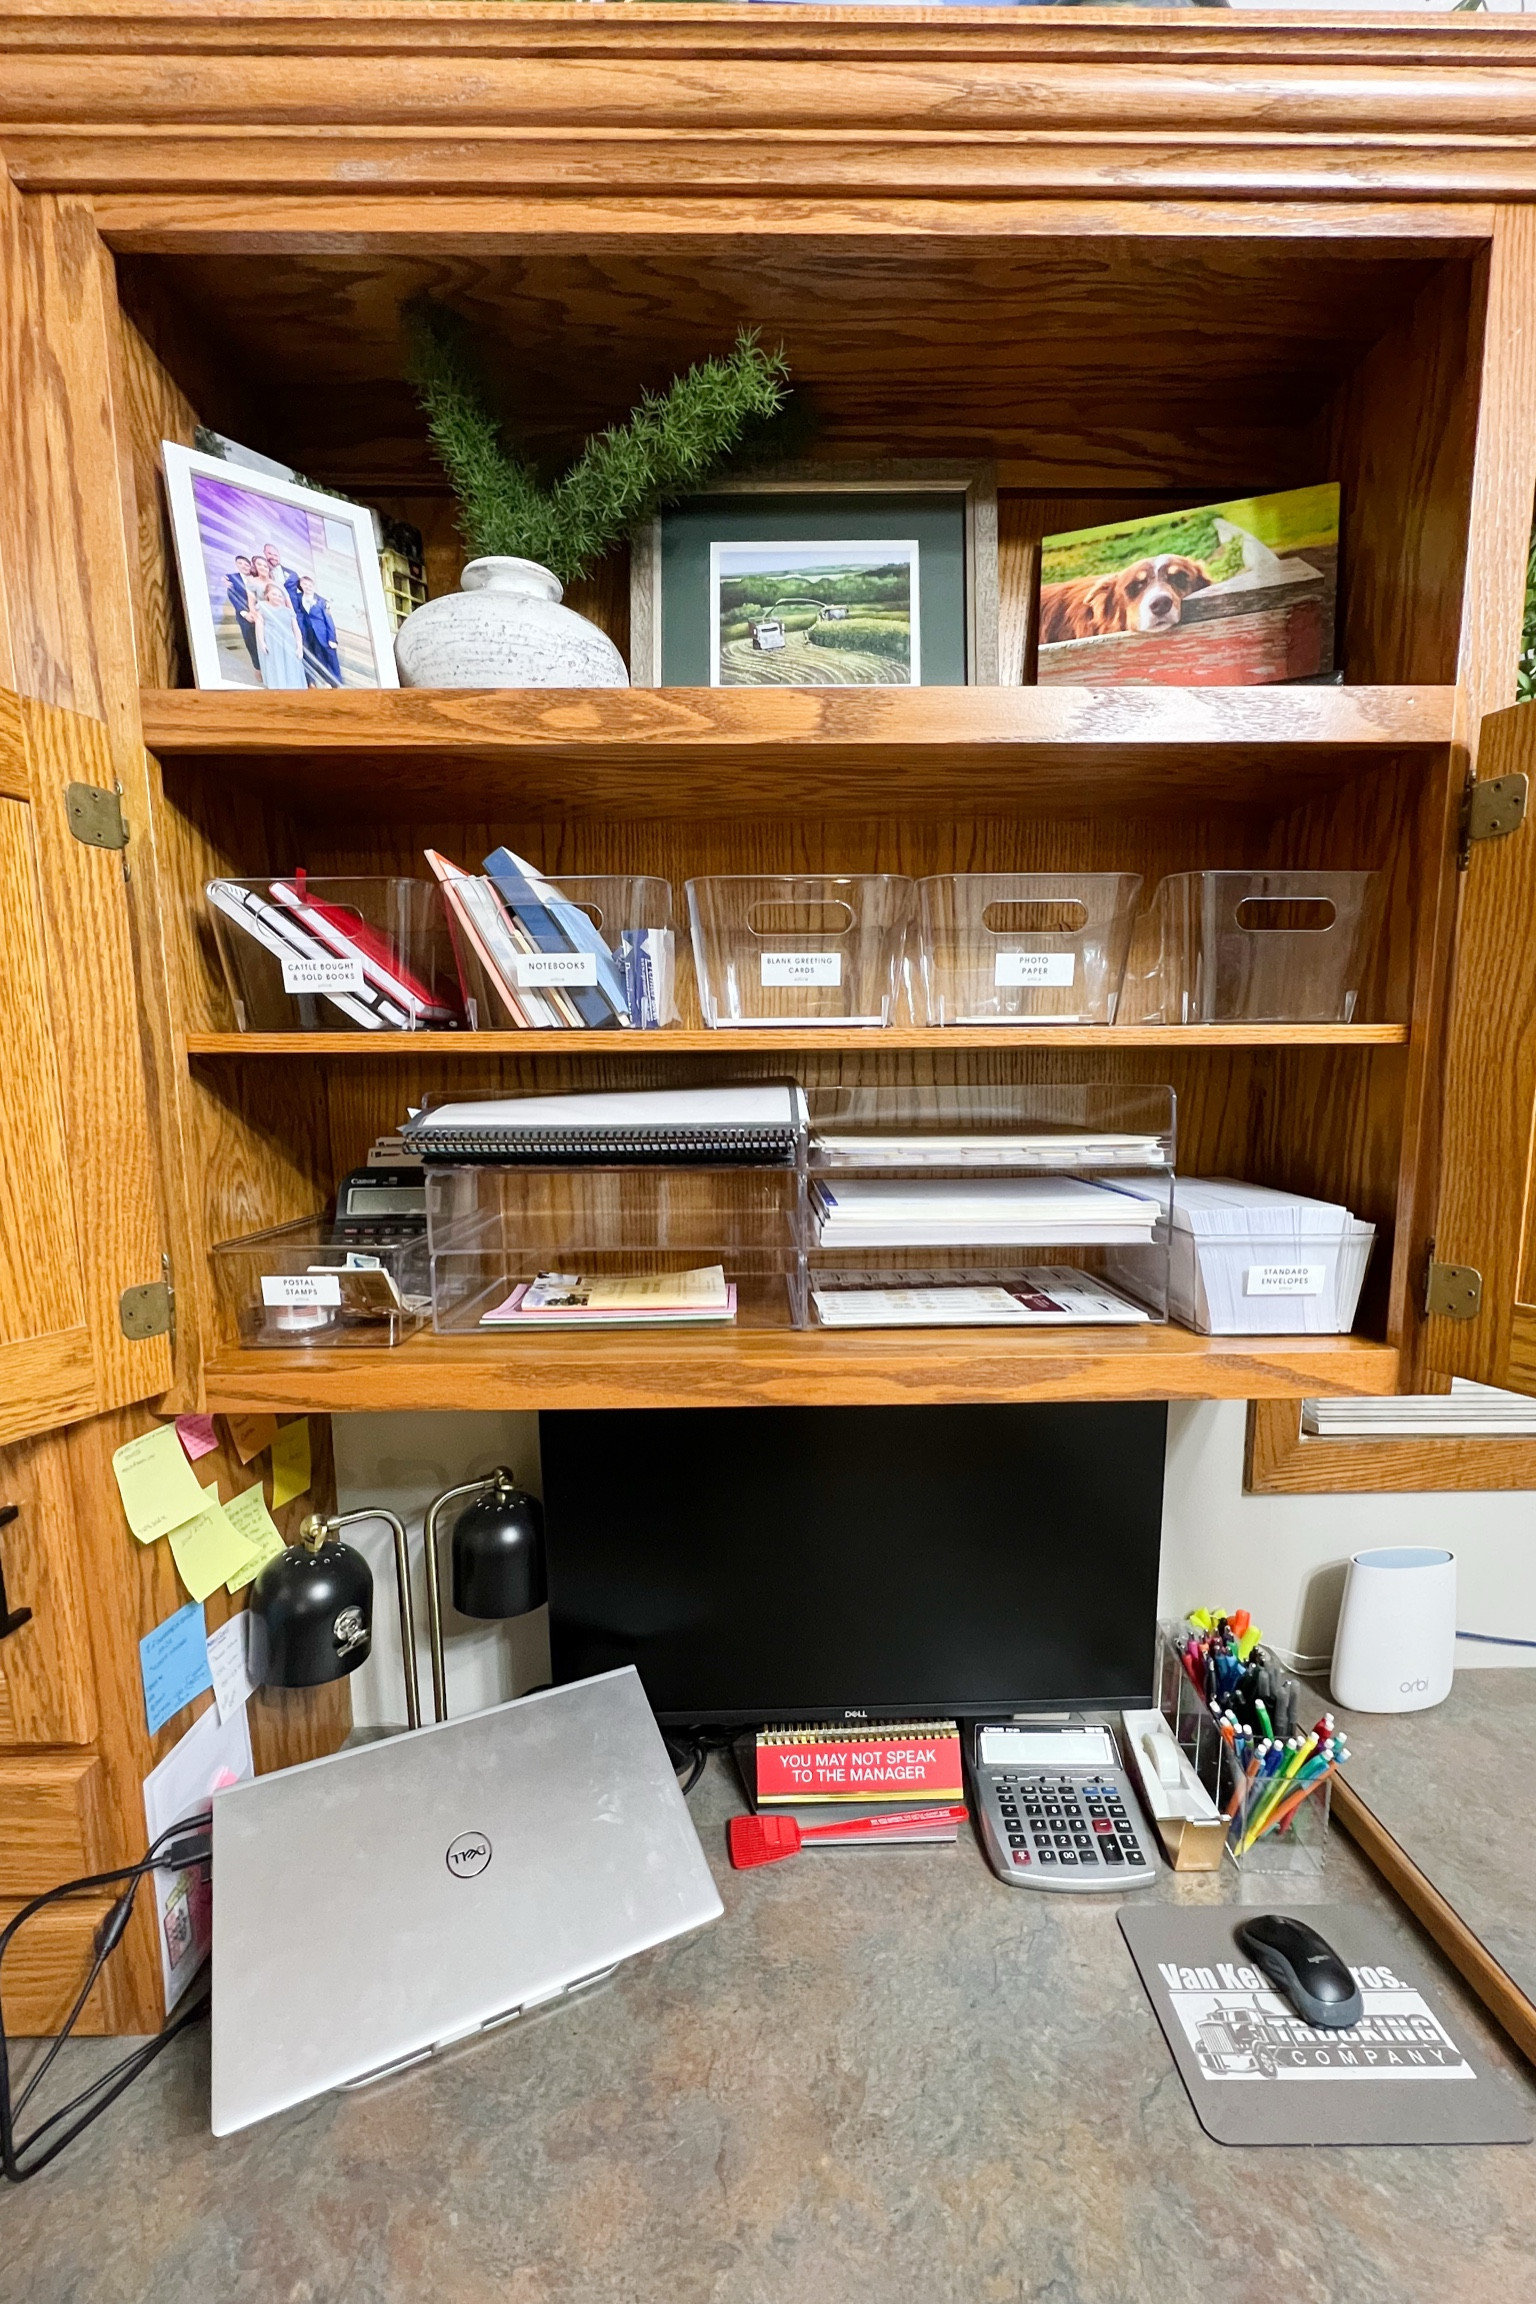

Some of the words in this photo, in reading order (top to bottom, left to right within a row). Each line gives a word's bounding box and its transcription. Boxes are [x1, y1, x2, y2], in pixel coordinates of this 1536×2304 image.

[767, 957, 792, 965] BLANK
[794, 957, 833, 965] GREETING
[1019, 956, 1049, 965] PHOTO
[287, 962, 317, 971] CATTLE
[320, 961, 354, 971] BOUGHT
[528, 961, 586, 970] NOTEBOOKS
[788, 966, 815, 974] CARDS
[1021, 967, 1049, 975] PAPER
[301, 973, 323, 981] SOLD
[326, 972, 356, 980] BOOKS
[1261, 1277, 1309, 1285] ENVELOPES
[285, 1288, 318, 1296] STAMPS
[1399, 1676, 1429, 1693] orbi
[844, 1710, 868, 1718] DELL
[780, 1754, 812, 1768] YOU
[815, 1753, 847, 1767] MAY
[852, 1751, 882, 1766] NOT
[886, 1749, 936, 1764] SPEAK
[792, 1769, 813, 1783] TO
[817, 1768, 845, 1782] THE
[850, 1766, 926, 1781] MANAGER
[1157, 1963, 1220, 1989] Van
[1347, 1966, 1409, 1989] ros.
[1291, 2049, 1447, 2066] COMPANY
